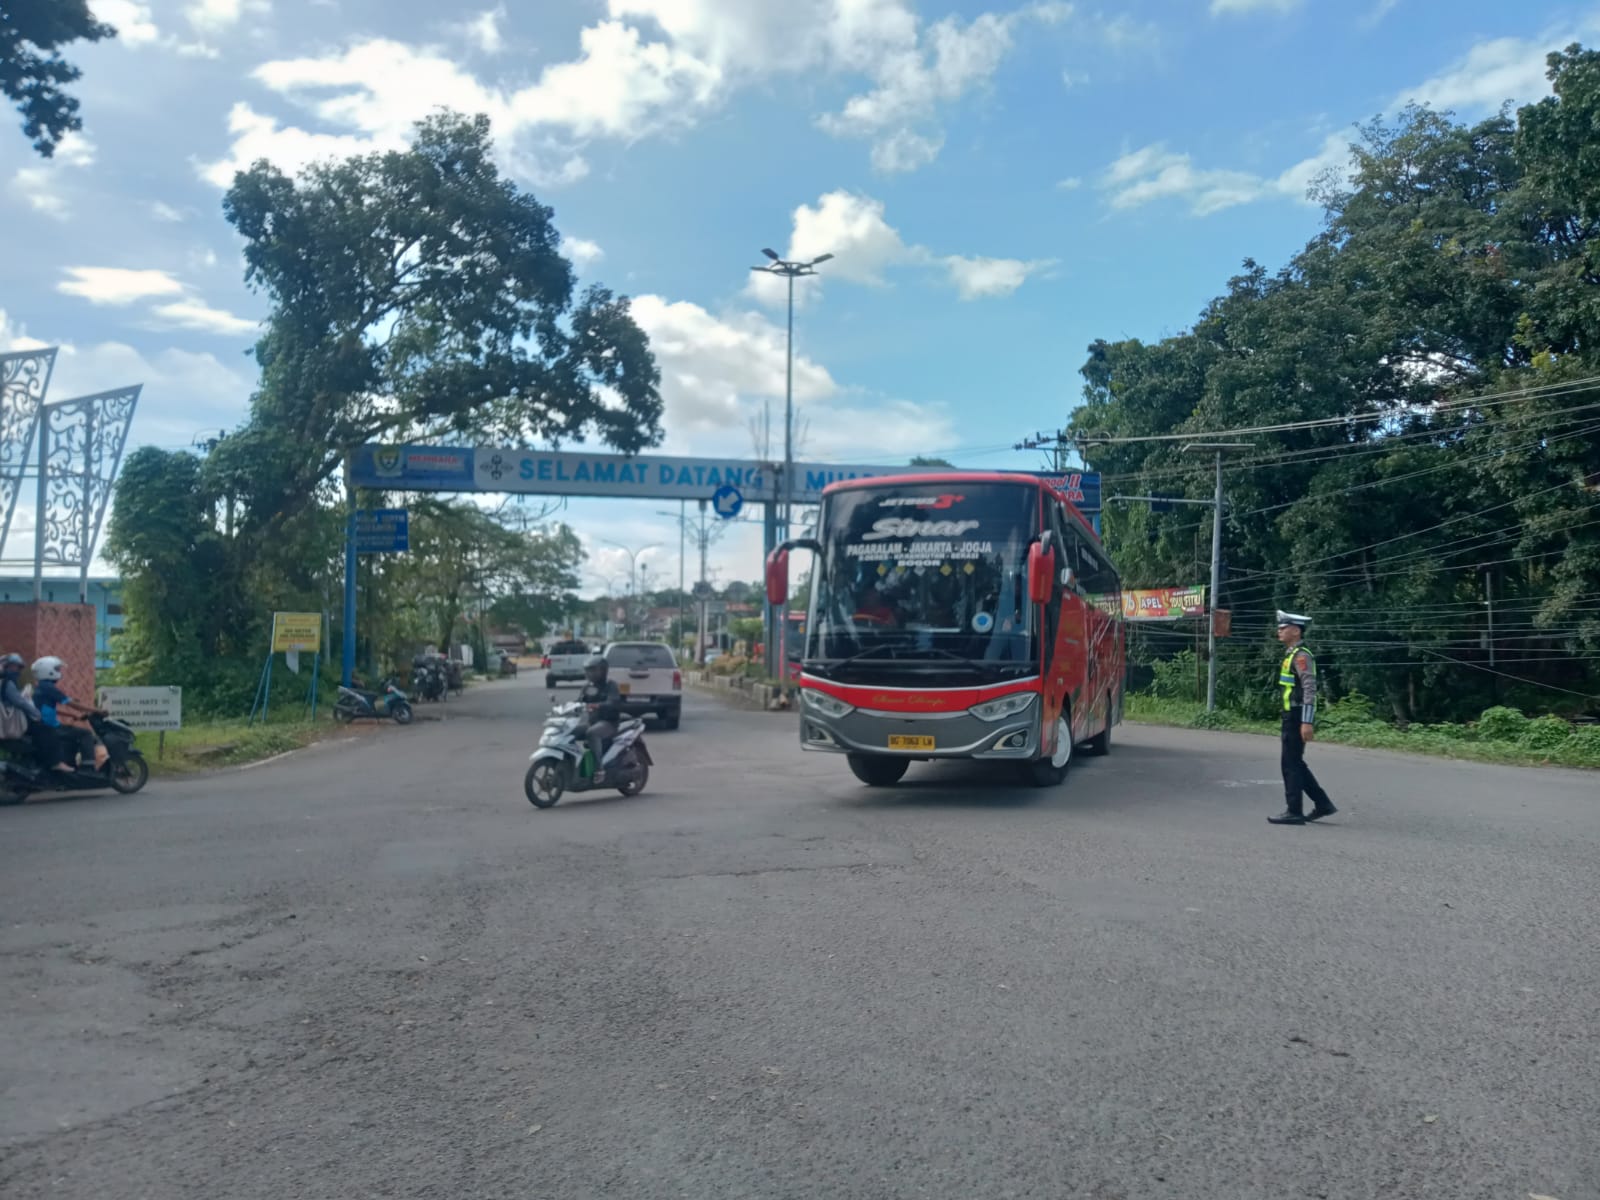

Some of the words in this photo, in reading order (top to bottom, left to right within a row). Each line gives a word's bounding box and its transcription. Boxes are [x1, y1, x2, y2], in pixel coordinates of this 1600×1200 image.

[519, 458, 648, 485] SELAMAT
[658, 463, 762, 488] DATANG
[862, 517, 980, 540] Sinar
[847, 543, 903, 557] PAGARALAM
[908, 542, 952, 554] JAKARTA
[959, 541, 992, 553] JOGJA
[897, 559, 941, 567] BOGOR
[1141, 597, 1162, 609] APEL
